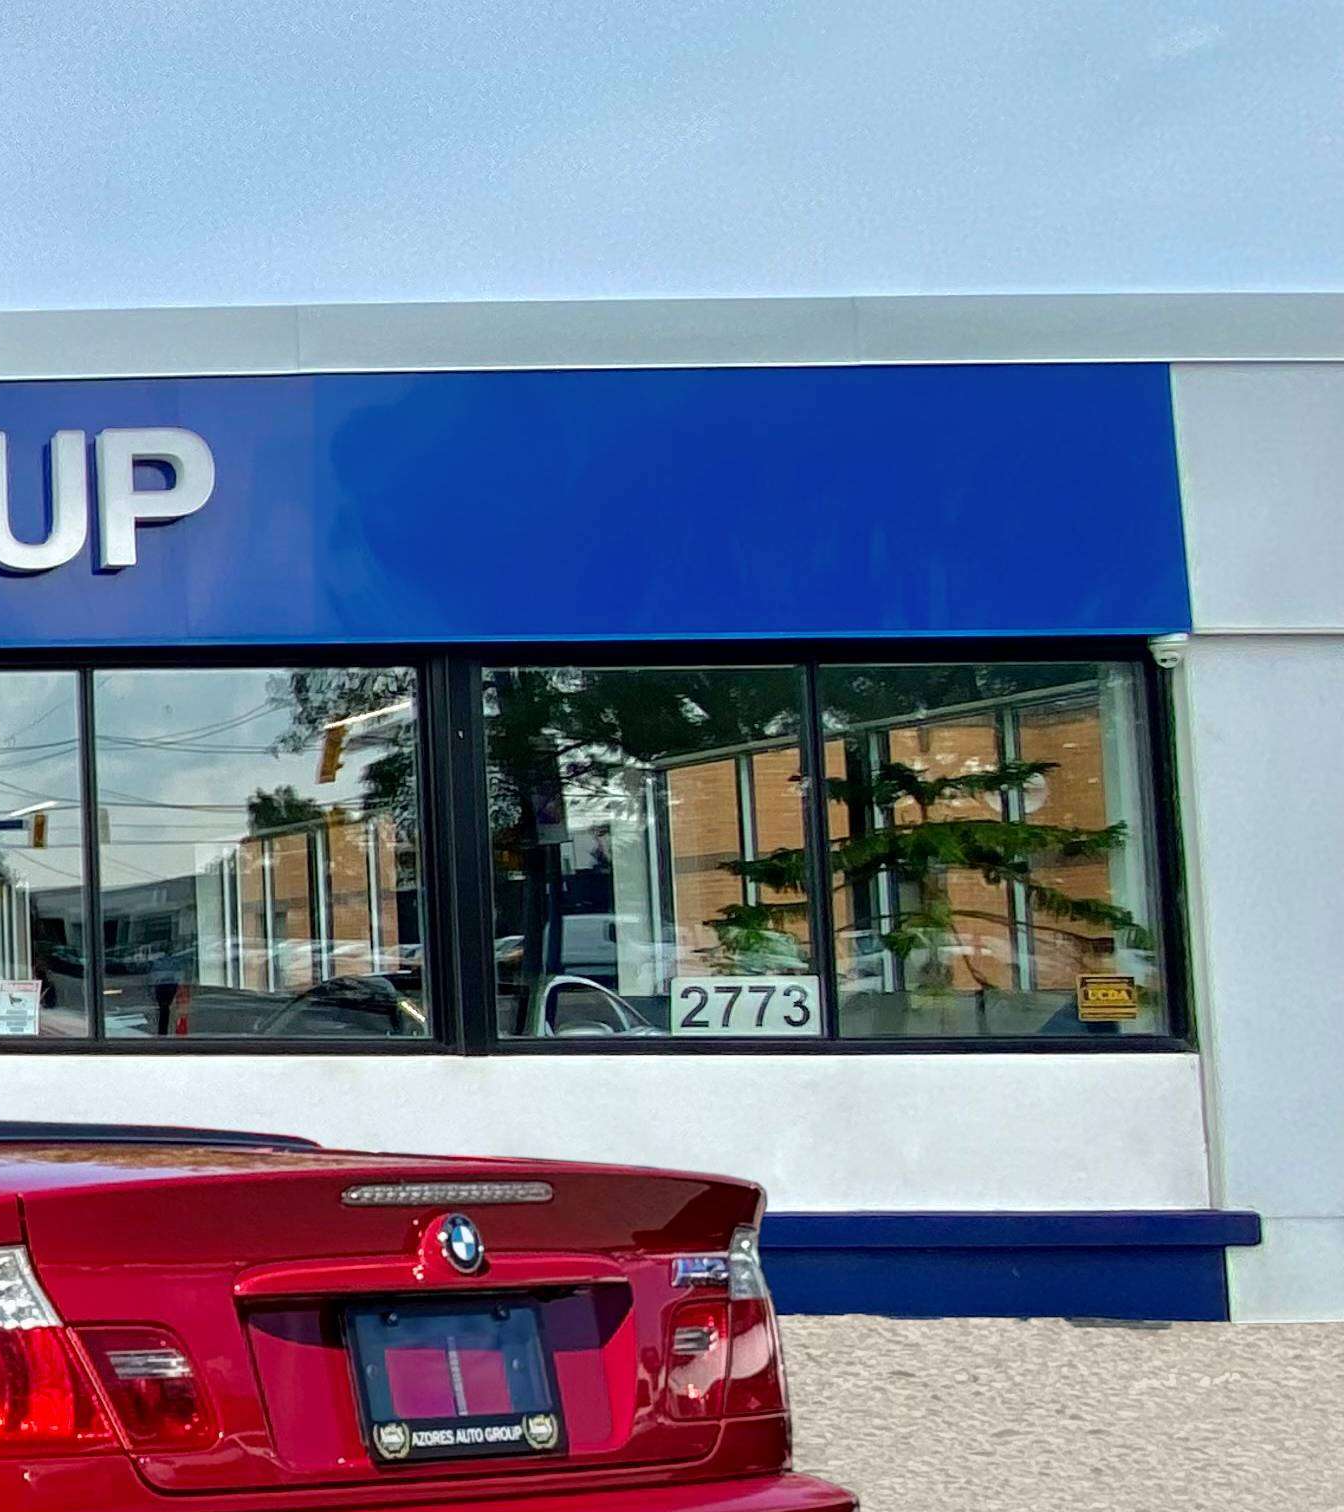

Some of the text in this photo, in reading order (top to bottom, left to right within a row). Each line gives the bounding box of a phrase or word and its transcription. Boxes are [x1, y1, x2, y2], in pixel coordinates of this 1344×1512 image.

[680, 985, 810, 1028] 2773
[412, 1430, 454, 1447] AZORES
[455, 1427, 483, 1443] AUTO
[485, 1426, 522, 1442] GROUP
